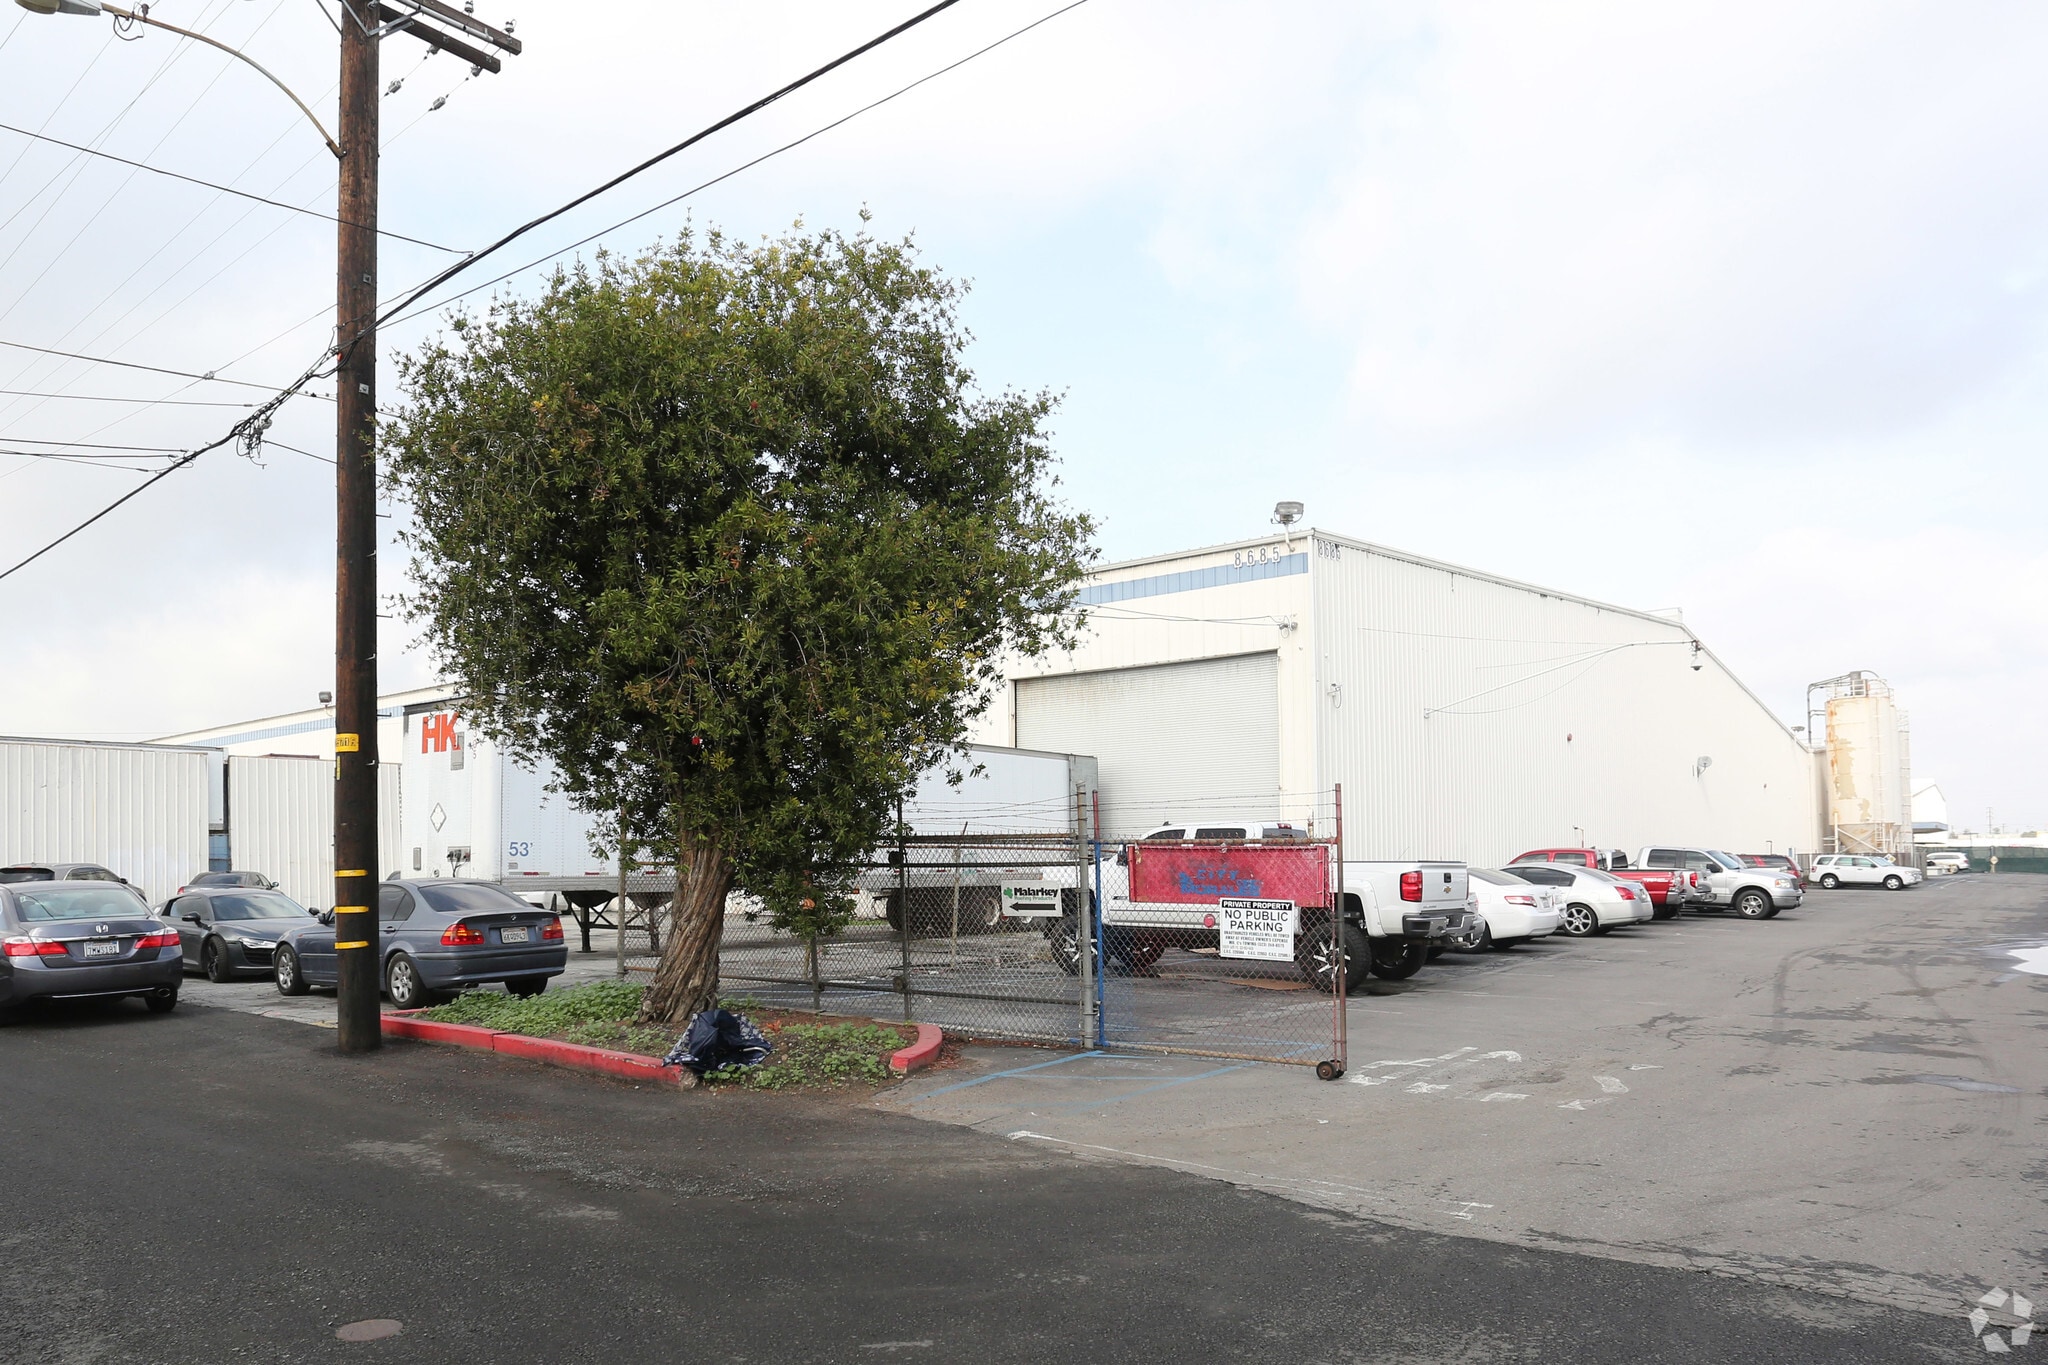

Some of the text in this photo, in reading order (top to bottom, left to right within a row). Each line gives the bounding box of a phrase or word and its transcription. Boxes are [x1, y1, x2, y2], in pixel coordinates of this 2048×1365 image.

[1234, 545, 1281, 567] 8685
[1318, 541, 1340, 561] 8685
[421, 712, 461, 754] HK
[509, 841, 533, 857] 53'
[1013, 887, 1058, 897] Malarkey
[1252, 902, 1290, 910] PROPERTY
[1225, 909, 1288, 921] NO PUBLIC
[1230, 920, 1283, 932] PARKING
